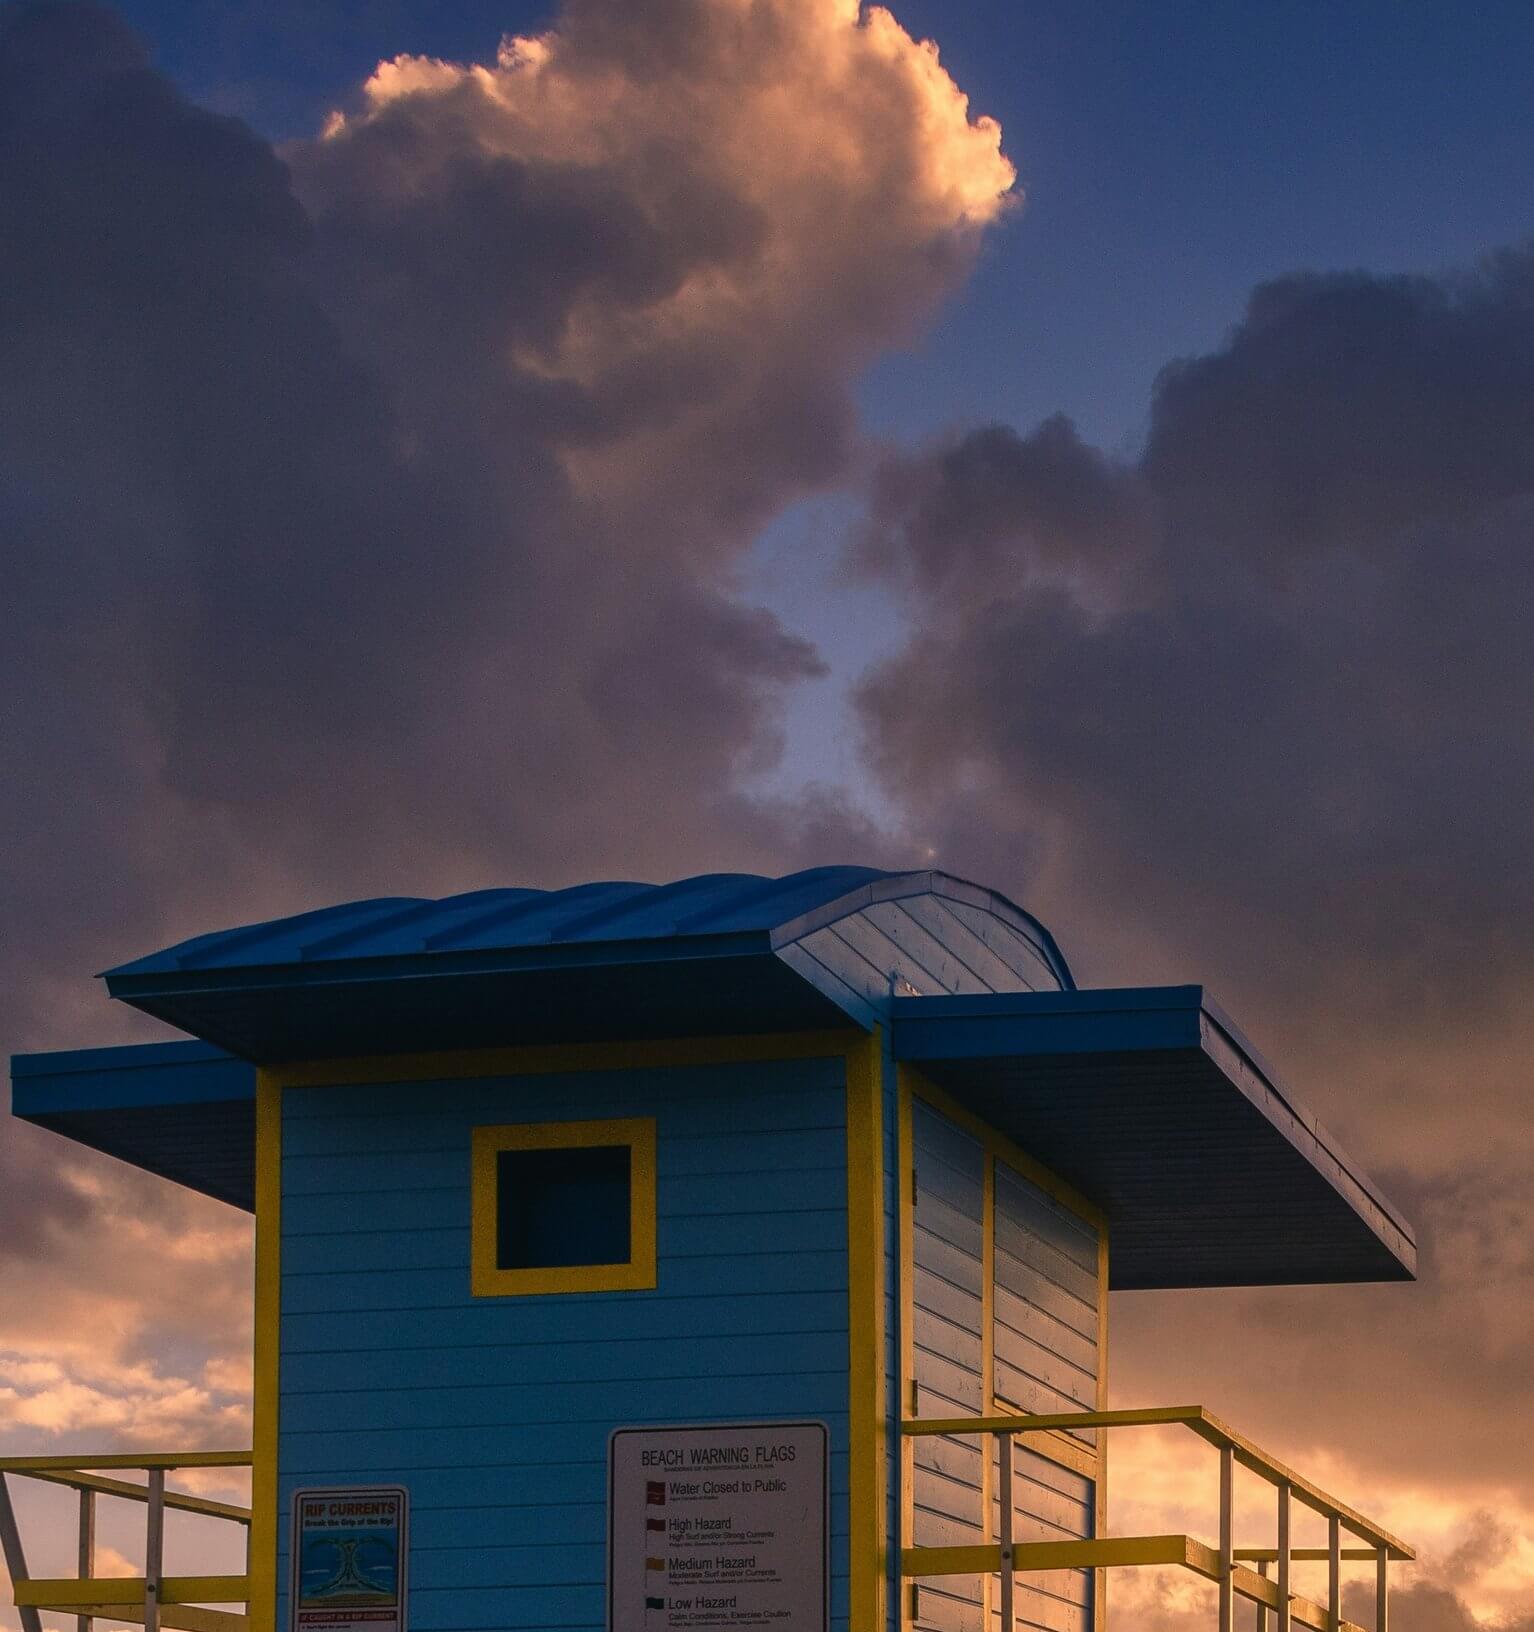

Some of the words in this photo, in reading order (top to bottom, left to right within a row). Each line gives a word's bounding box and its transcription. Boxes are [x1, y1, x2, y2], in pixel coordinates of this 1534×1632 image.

[641, 1450, 684, 1466] BEACH
[690, 1447, 749, 1465] WARNING
[755, 1445, 796, 1462] FLAGS
[669, 1482, 700, 1495] Water
[702, 1481, 739, 1494] Closed
[742, 1481, 752, 1492] to
[754, 1479, 787, 1492] Public
[304, 1504, 326, 1516] RIP
[329, 1502, 396, 1515] CURRENTS
[304, 1519, 327, 1527] Break
[327, 1519, 339, 1527] the
[340, 1518, 356, 1527] Grip
[366, 1517, 378, 1525] the
[668, 1517, 692, 1533] High
[695, 1516, 731, 1529] Hazard
[668, 1533, 685, 1542] High
[686, 1532, 700, 1540] Surf
[701, 1532, 722, 1540] and/or
[723, 1531, 745, 1540] Strong
[746, 1530, 774, 1538] Currents
[668, 1557, 713, 1570] Medium
[715, 1555, 756, 1569] Hazard
[668, 1571, 703, 1579] Moderate
[704, 1570, 720, 1578] Surf
[720, 1569, 744, 1577] and/or
[745, 1568, 776, 1576] Currents
[668, 1597, 692, 1610] Low
[695, 1595, 737, 1609] Hazard
[668, 1612, 688, 1620] Calm
[731, 1611, 761, 1619] Exercise
[763, 1609, 791, 1618] Caution
